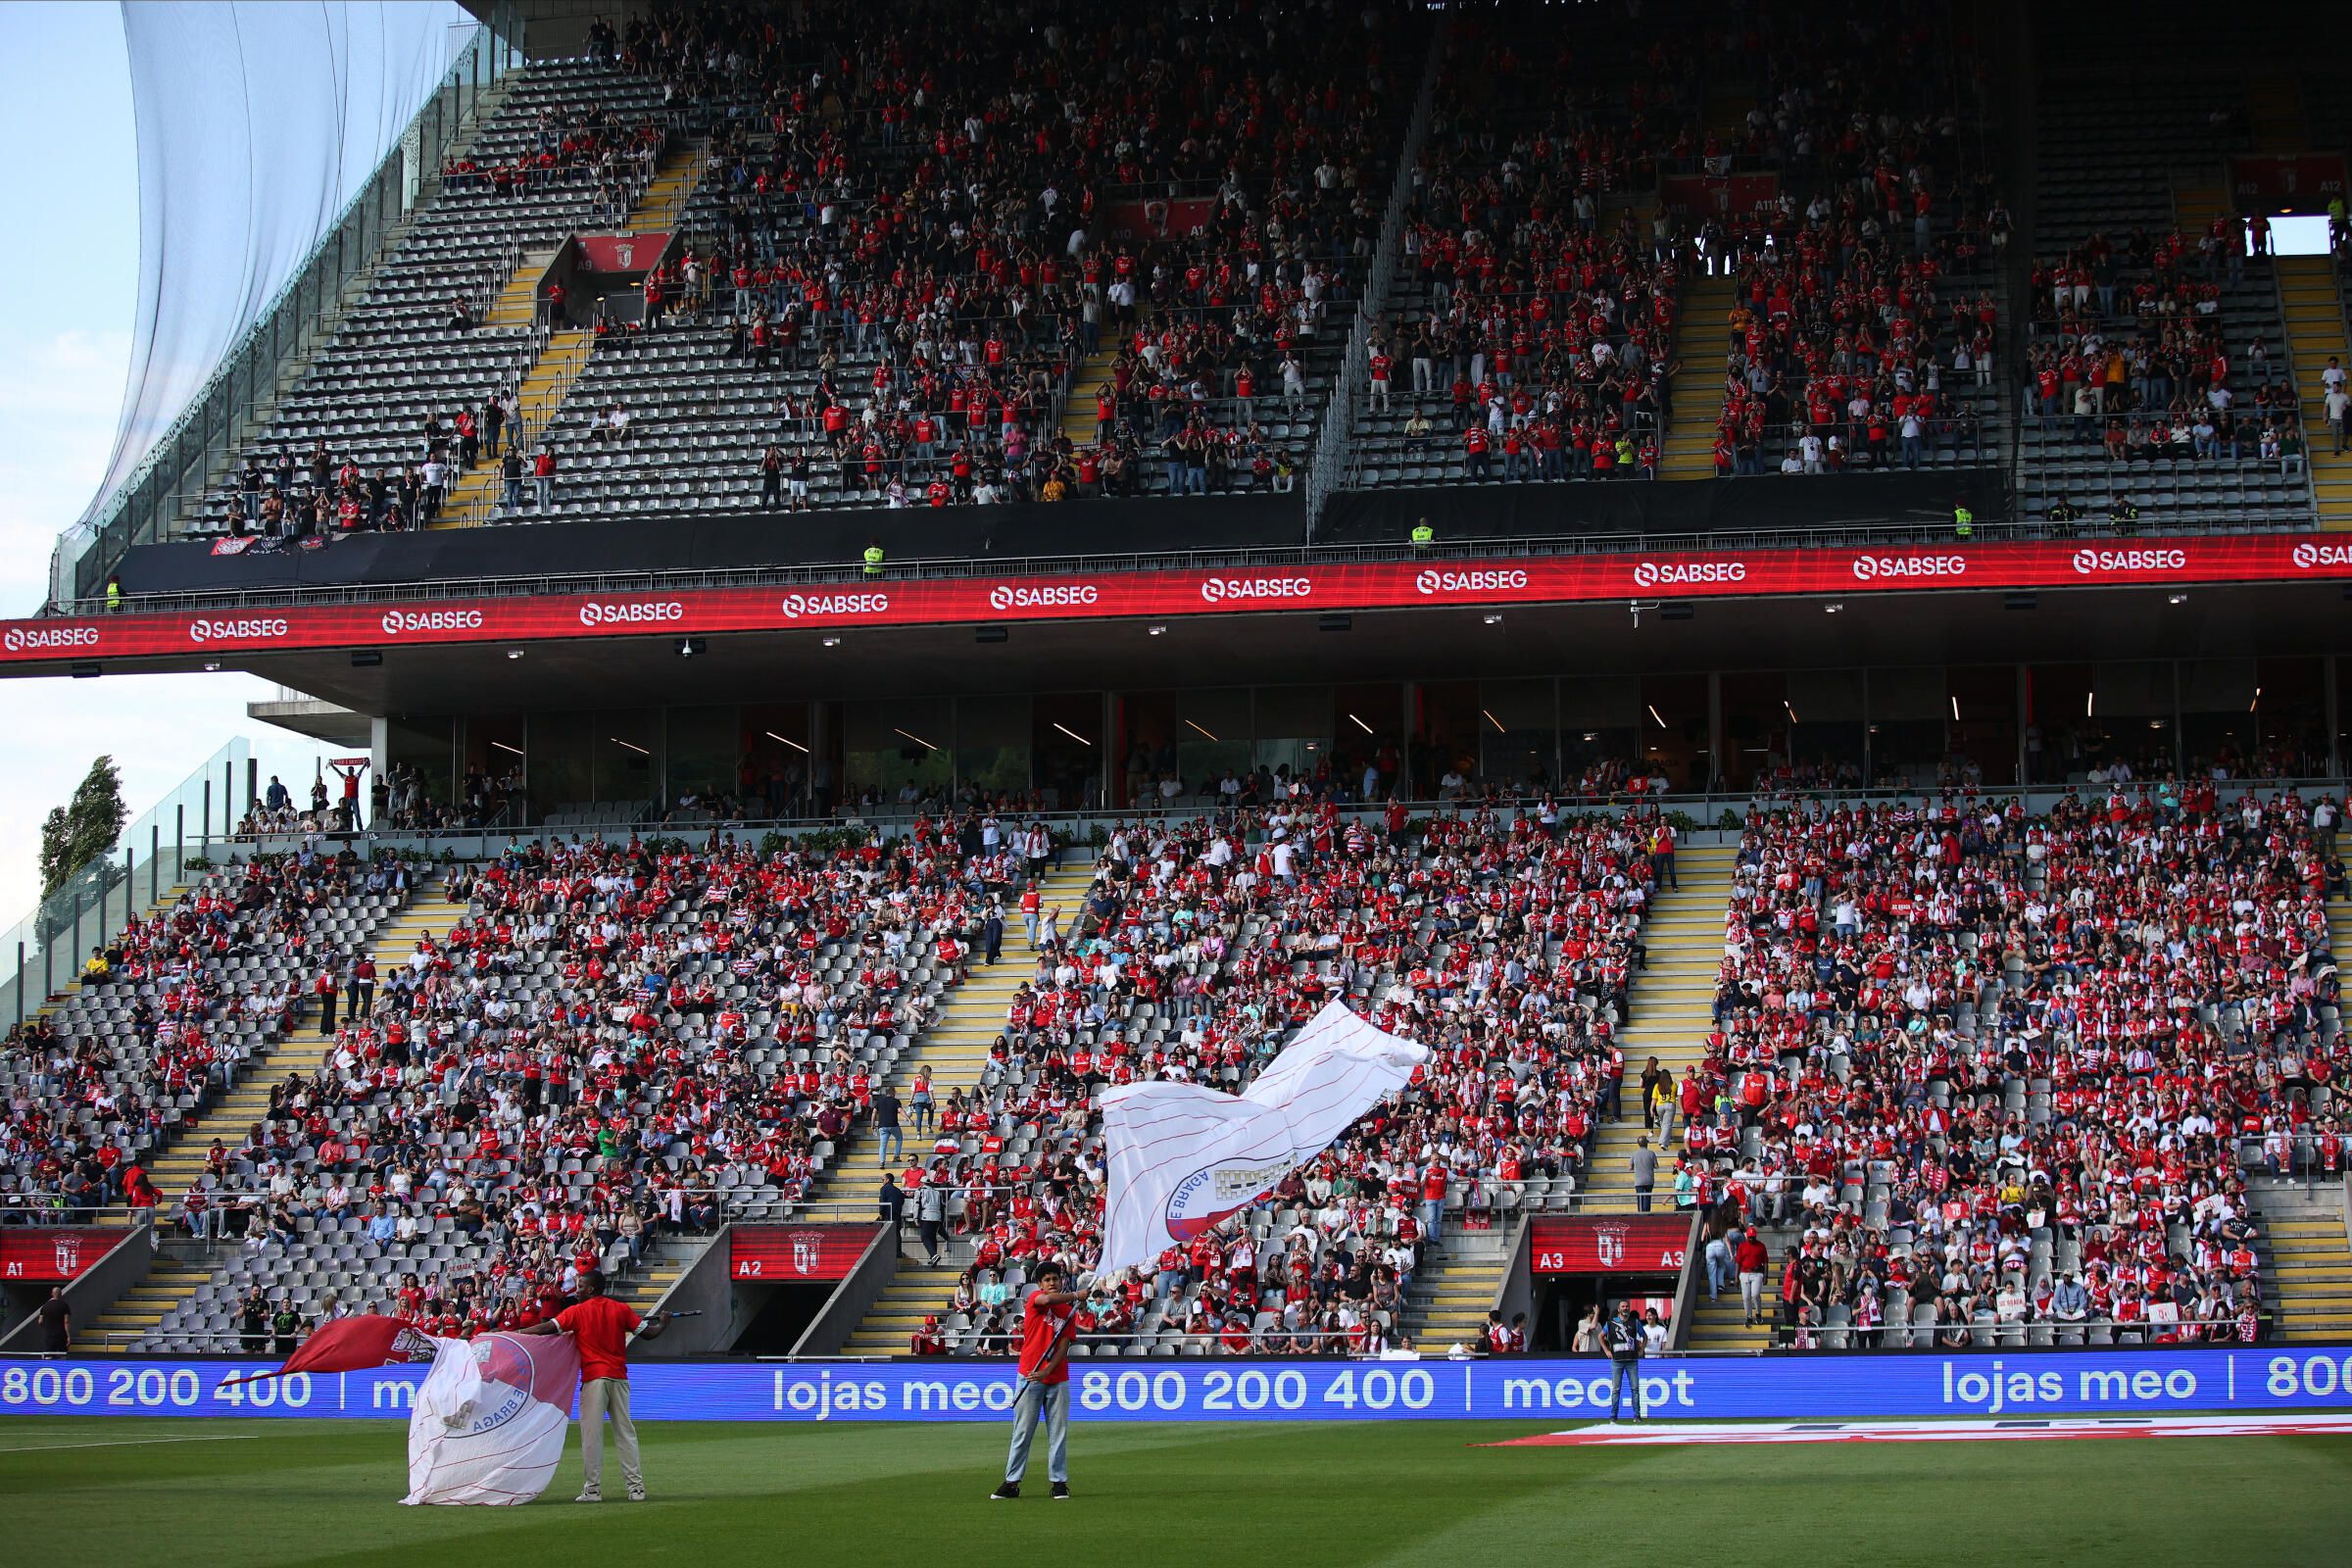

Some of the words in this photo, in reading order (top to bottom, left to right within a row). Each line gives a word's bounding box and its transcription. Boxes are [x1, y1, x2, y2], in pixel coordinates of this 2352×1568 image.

[1755, 199, 1773, 212] A11
[1190, 224, 1204, 237] A1
[576, 260, 594, 271] A9
[1881, 555, 1966, 577] SABSEG
[2099, 549, 2186, 570] SABSEG
[1443, 569, 1528, 591] SABSEG
[1660, 562, 1746, 583] SABSEG
[1015, 585, 1099, 607] SABSEG
[1227, 577, 1311, 599] SABSEG
[604, 602, 683, 623] SABSEG
[808, 593, 888, 614] SABSEG
[213, 618, 287, 639] SABSEG
[406, 610, 482, 631] SABSEG
[25, 627, 99, 649] SABSEG
[6, 1261, 24, 1276] A1
[738, 1260, 761, 1276] A2
[1539, 1252, 1564, 1269] A3
[1660, 1250, 1685, 1267] A3
[2, 1367, 94, 1405] 800
[108, 1368, 200, 1407] 200
[214, 1371, 312, 1408] 400
[773, 1370, 887, 1421] lojas
[903, 1381, 1014, 1411] meo
[1080, 1370, 1187, 1411] 800
[1202, 1369, 1307, 1411] 200
[1323, 1369, 1435, 1410] 400
[1503, 1369, 1694, 1419] meo.pt
[1942, 1360, 2064, 1414] lojas
[2080, 1370, 2197, 1401] meo
